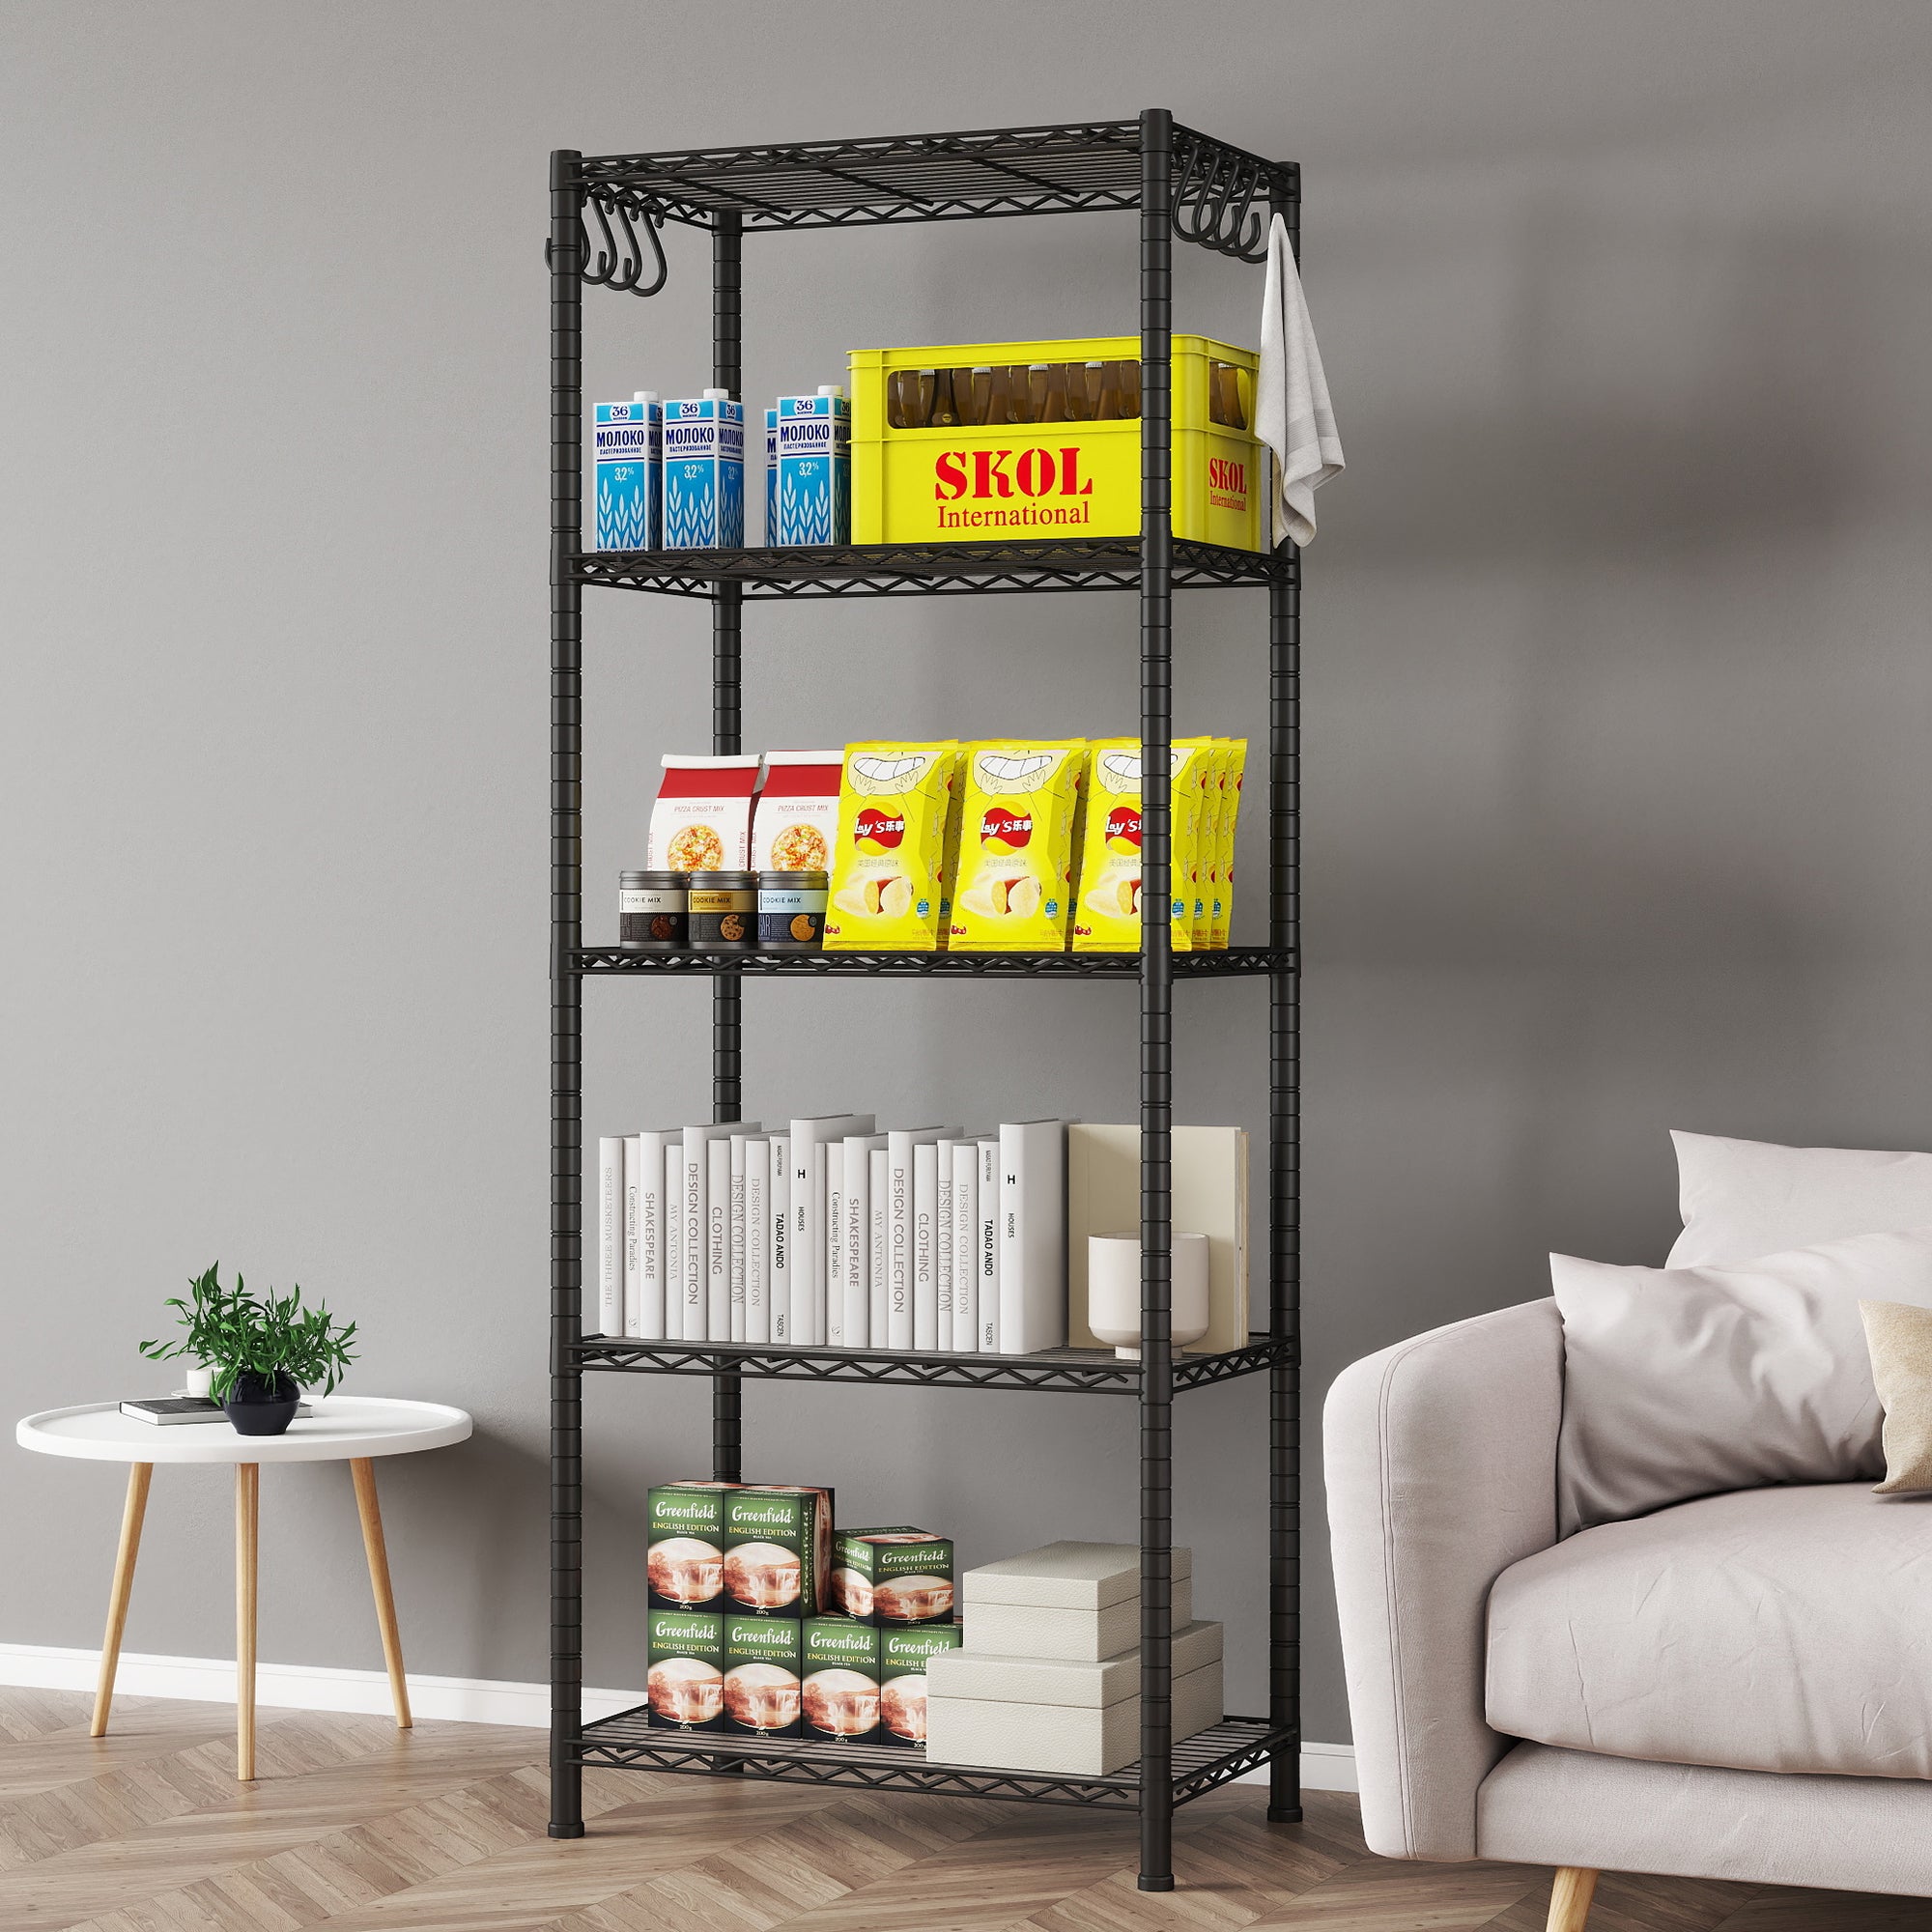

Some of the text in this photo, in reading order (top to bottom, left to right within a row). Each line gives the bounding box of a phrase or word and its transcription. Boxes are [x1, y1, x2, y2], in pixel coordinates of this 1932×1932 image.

[612, 406, 628, 416] 36
[682, 404, 697, 413] 36
[726, 405, 735, 415] 36
[797, 400, 812, 411] 36
[596, 430, 644, 447] МОЛОКО
[666, 427, 714, 445] МОЛОКО
[719, 428, 744, 447] МОЛОКО
[781, 424, 830, 442] МОЛОКО
[935, 447, 1093, 500] SKOL
[1209, 457, 1247, 495] SKOL
[1209, 491, 1246, 511] International
[937, 501, 1091, 528] International
[798, 1169, 806, 1179] H
[1008, 1175, 1015, 1184] H
[628, 1185, 637, 1236] Constructing
[669, 1204, 677, 1222] MY
[875, 1209, 882, 1228] MY
[645, 1192, 654, 1279] SHAKESPEARE
[688, 1163, 697, 1305] DESIGN COLLECTION
[712, 1207, 723, 1275] CLOTHING
[731, 1175, 744, 1304] DESIGN COLLECTION
[752, 1179, 760, 1307] DESIGN COLLECTION
[776, 1213, 784, 1269] TADAO ANDO
[831, 1191, 840, 1278] Constructing Paradies
[850, 1198, 859, 1287] SHAKESPEARE
[894, 1169, 904, 1313] DESIGN COLLECTION
[919, 1213, 929, 1283] CLOTHING
[939, 1180, 952, 1312] DESIGN COLLECTION
[959, 1184, 968, 1315] DESIGN COLLECTION
[984, 1219, 993, 1276] TADAO ANDO
[655, 1501, 715, 1520] Greenfield
[732, 1506, 793, 1523] Greenfield
[652, 1521, 720, 1533] ENGLISH EDITION
[728, 1526, 797, 1537] ENGLISH EDITION
[881, 1549, 945, 1564] Greenfield
[655, 1621, 715, 1639] Greenfield
[732, 1627, 792, 1645] Greenfield
[652, 1641, 720, 1653] ENGLISH EDITION
[810, 1632, 870, 1651] Greenfield
[889, 1637, 950, 1655] Greenfield
[728, 1647, 797, 1659] ENGLISH EDITION
[807, 1653, 876, 1664] ENGLISH EDITION
[886, 1659, 916, 1667] ENGLISH
